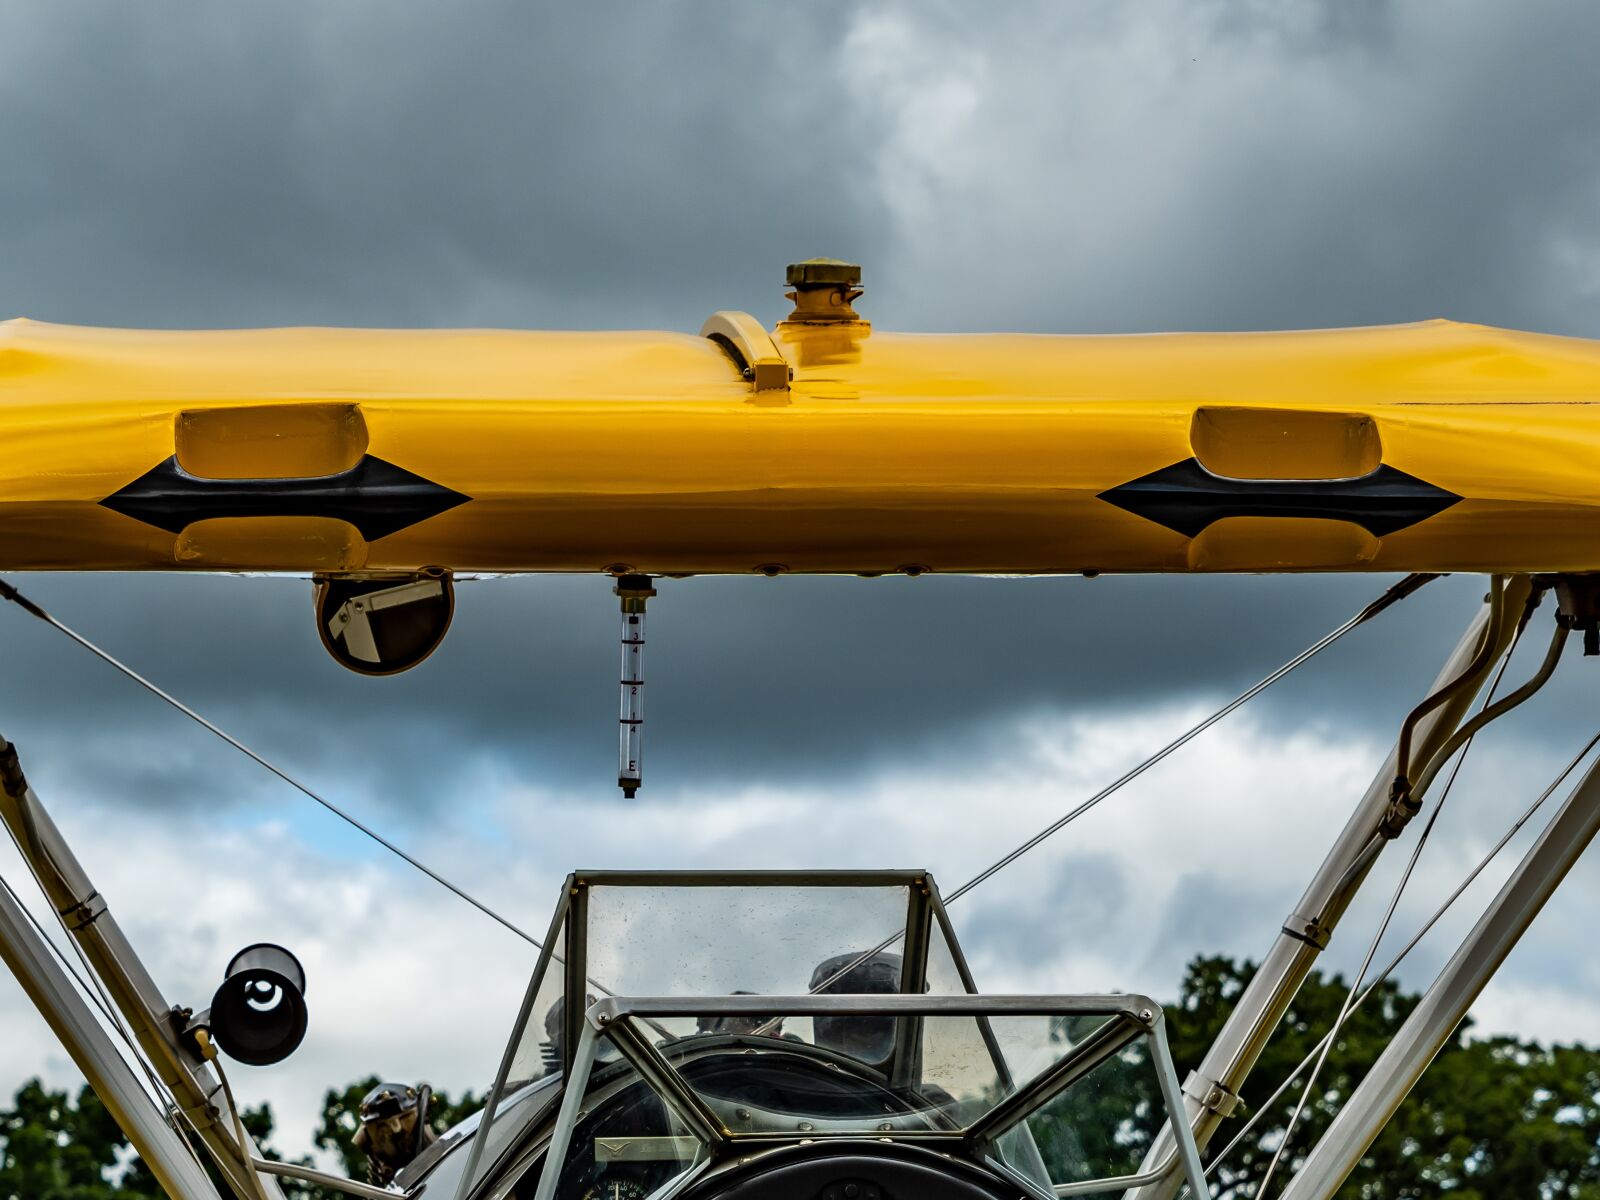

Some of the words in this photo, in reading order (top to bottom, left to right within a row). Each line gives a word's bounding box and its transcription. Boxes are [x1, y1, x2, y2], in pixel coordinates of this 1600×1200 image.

[633, 632, 639, 640] 3
[632, 646, 638, 654] 4
[631, 686, 637, 695] 2
[630, 726, 636, 734] 4
[629, 761, 636, 771] E
